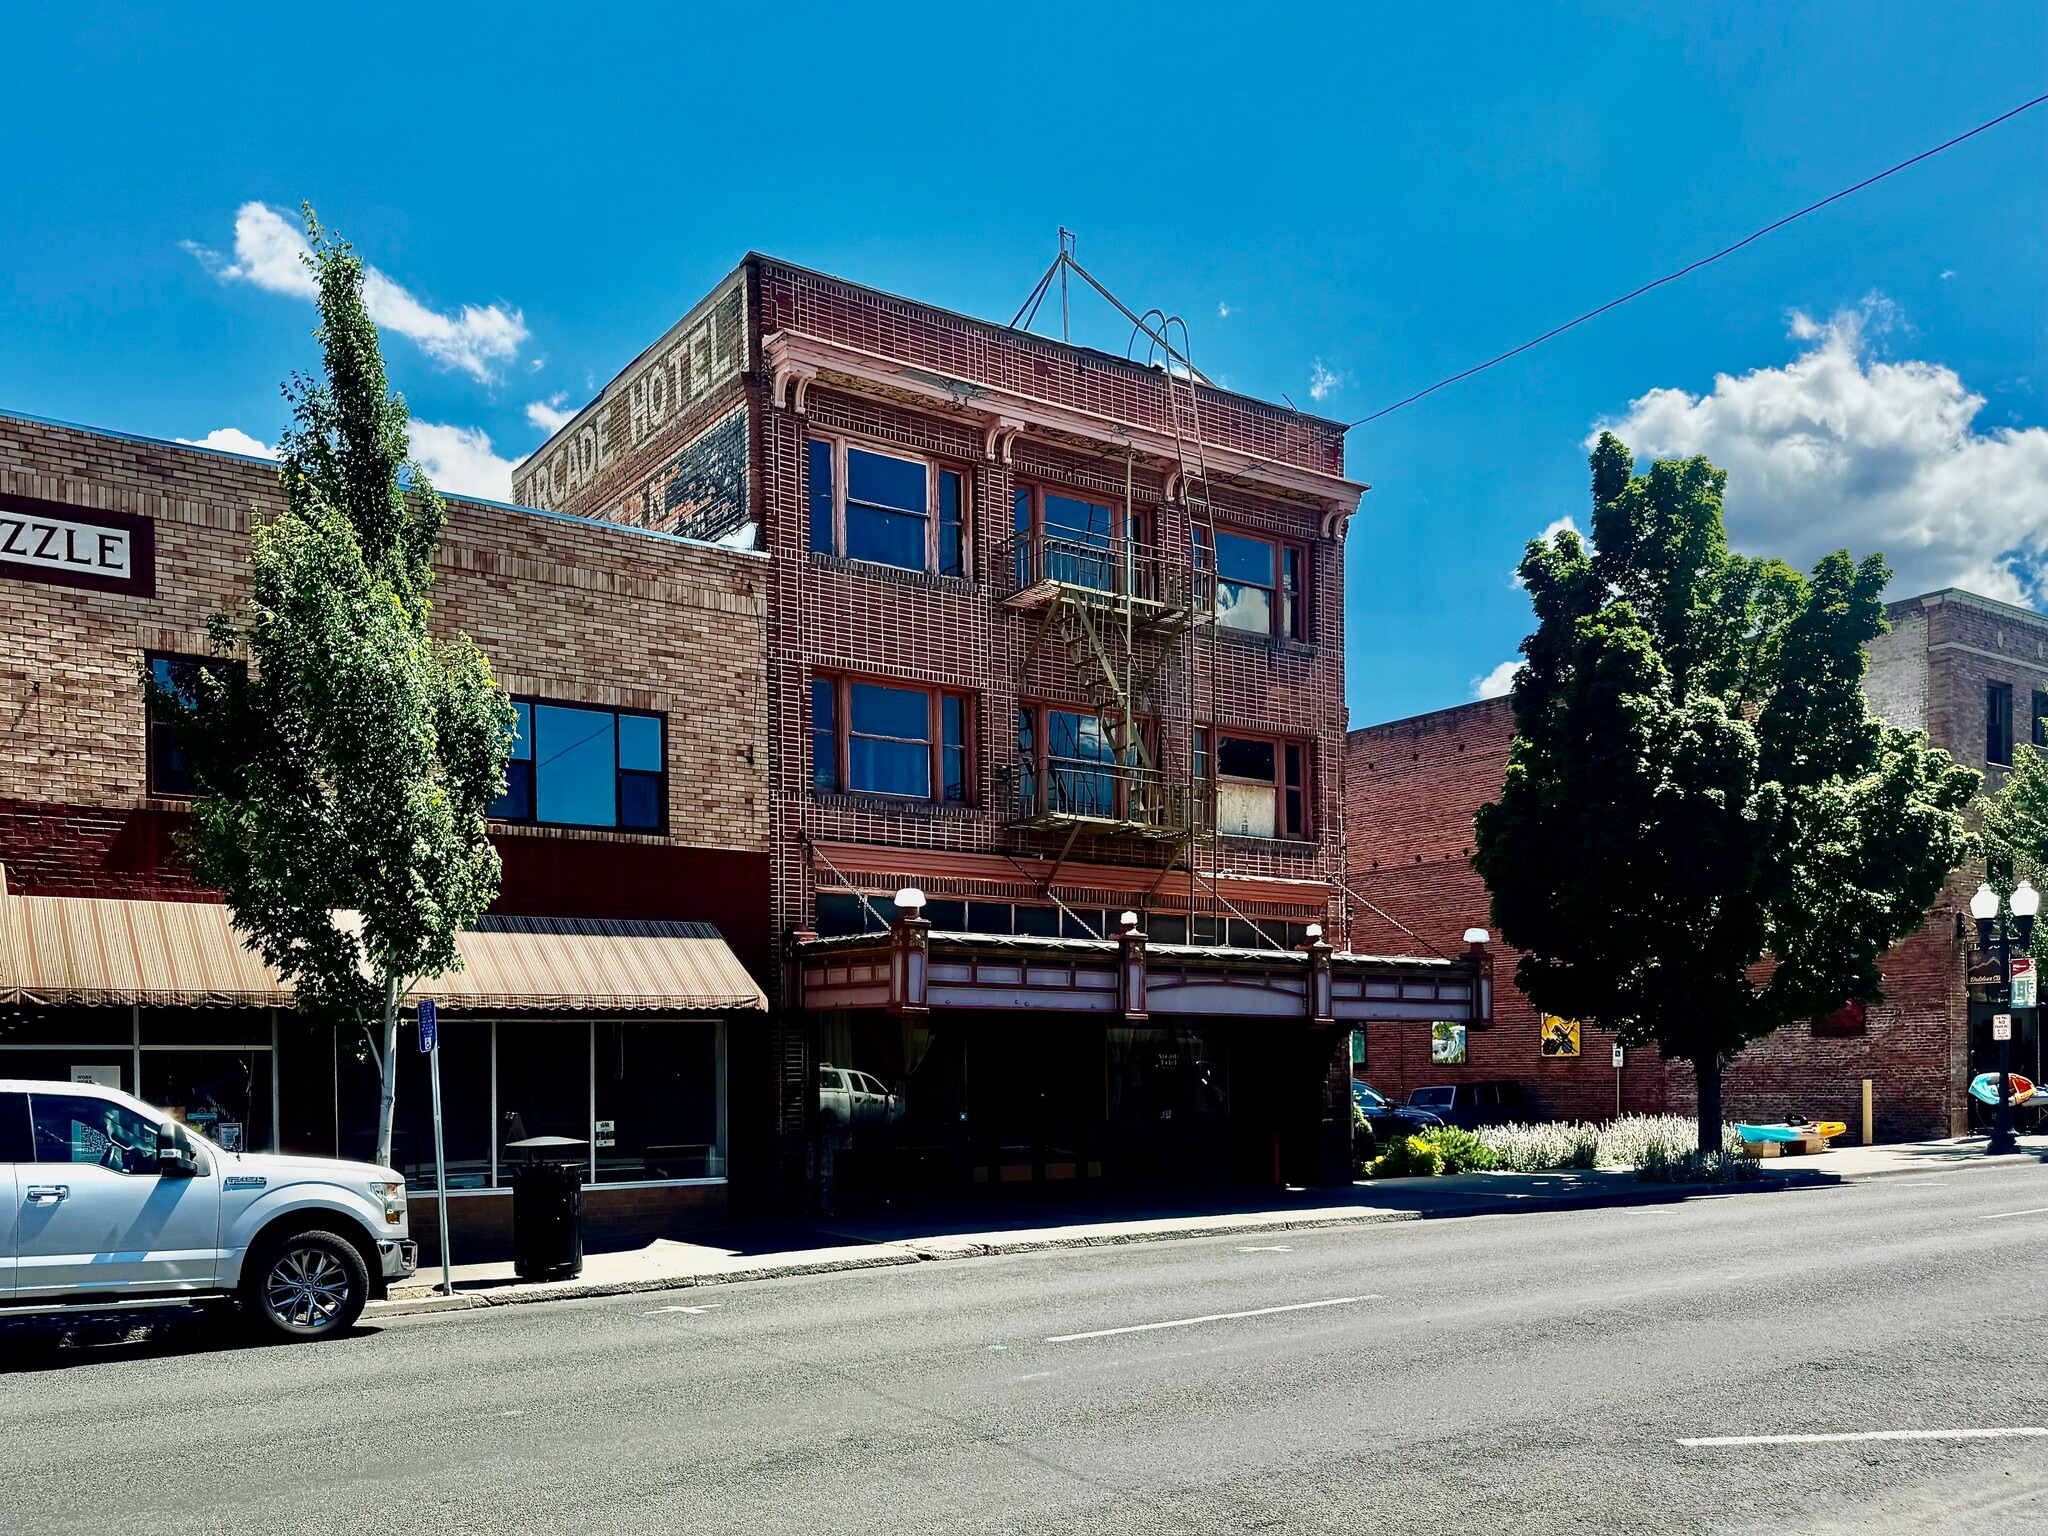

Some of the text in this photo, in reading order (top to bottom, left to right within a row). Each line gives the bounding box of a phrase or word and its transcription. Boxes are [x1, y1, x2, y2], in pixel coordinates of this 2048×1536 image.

[524, 406, 615, 511] ARCADE
[629, 312, 732, 446] HOTEL
[0, 518, 124, 570] ZZLE
